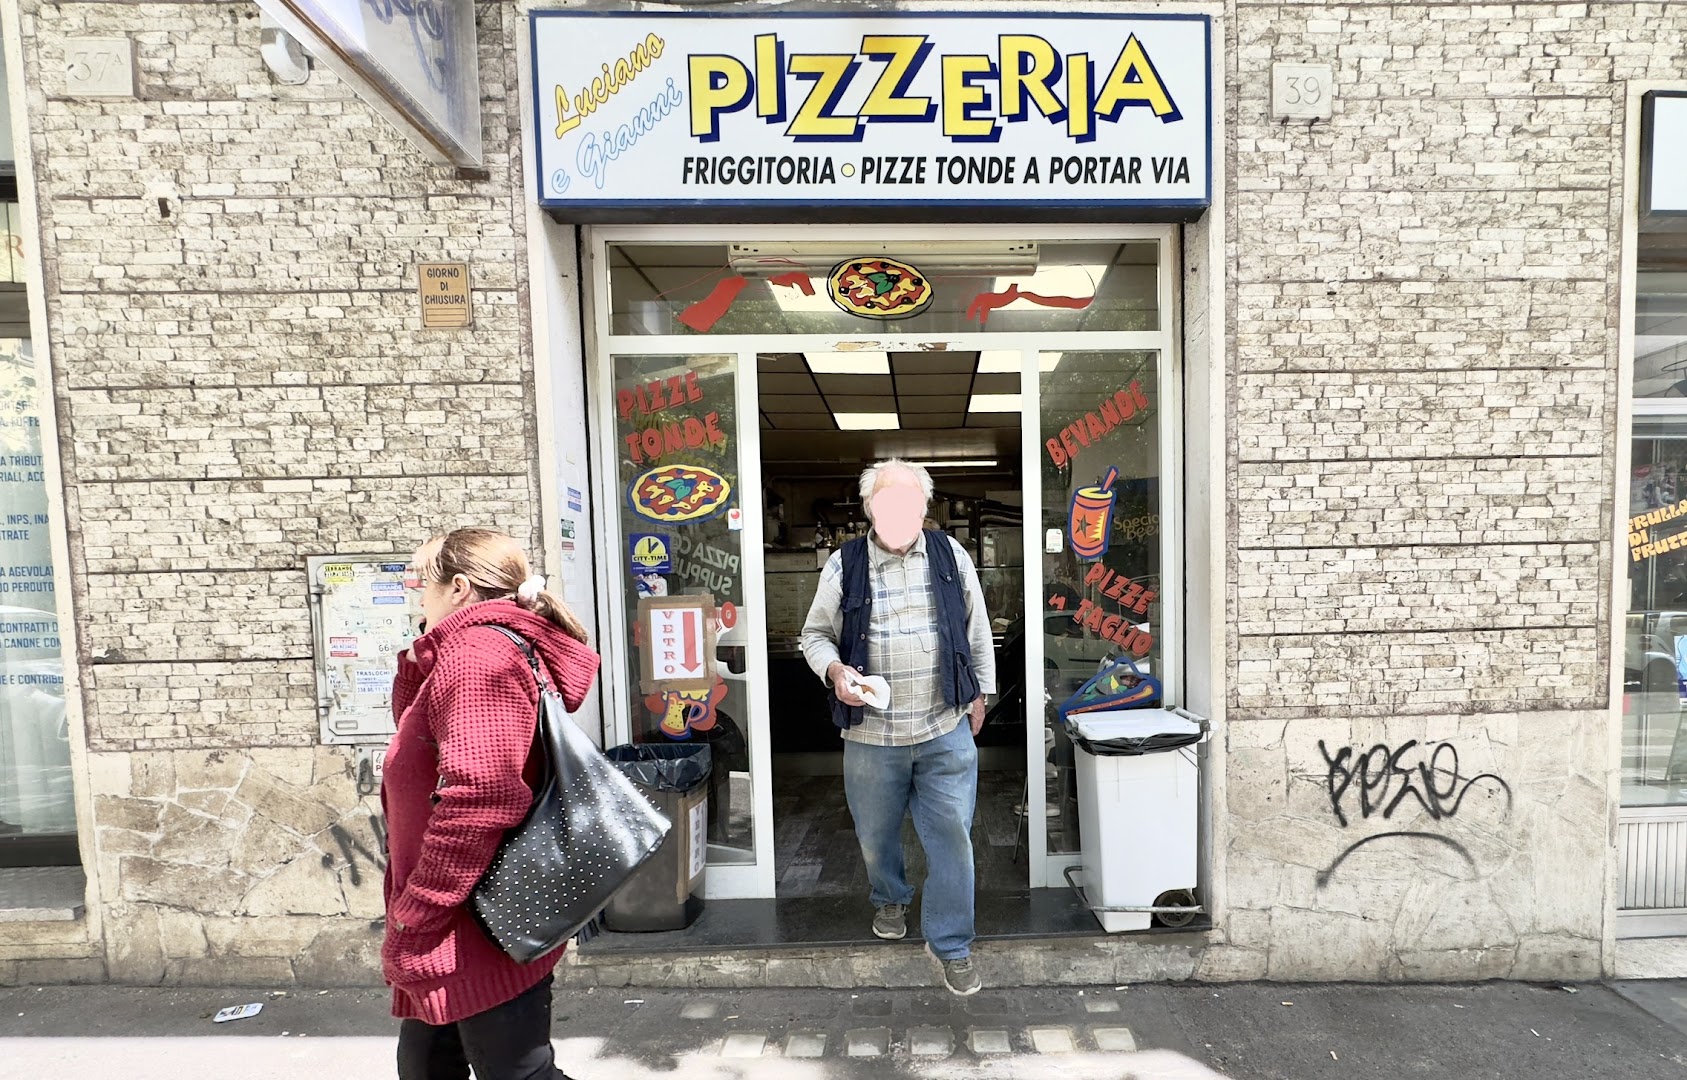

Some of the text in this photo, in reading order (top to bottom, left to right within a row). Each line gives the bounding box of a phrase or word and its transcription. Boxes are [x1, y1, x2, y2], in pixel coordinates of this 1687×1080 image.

[555, 33, 665, 139] Luciano
[688, 32, 1183, 142] PIZZERIA
[1285, 76, 1321, 105] 39
[551, 77, 683, 194] e Gianni
[682, 155, 1190, 185] FRIGGITORIA PIZZE TONDE A PORTAR VIA
[427, 267, 460, 279] GIORNO
[440, 281, 449, 292] DI
[424, 294, 467, 306] CHIUSURA
[617, 370, 704, 420] PIZZE
[625, 411, 725, 464] TONDE
[1045, 378, 1150, 469] BEVANDE
[9, 455, 44, 467] TRIBUT
[7, 514, 32, 526] INPS,
[1629, 529, 1649, 547] DI
[1084, 562, 1158, 615] PIZZE
[4, 637, 41, 648] CANONE
[662, 611, 676, 674] VETRO
[1072, 598, 1154, 656] TAGLIO
